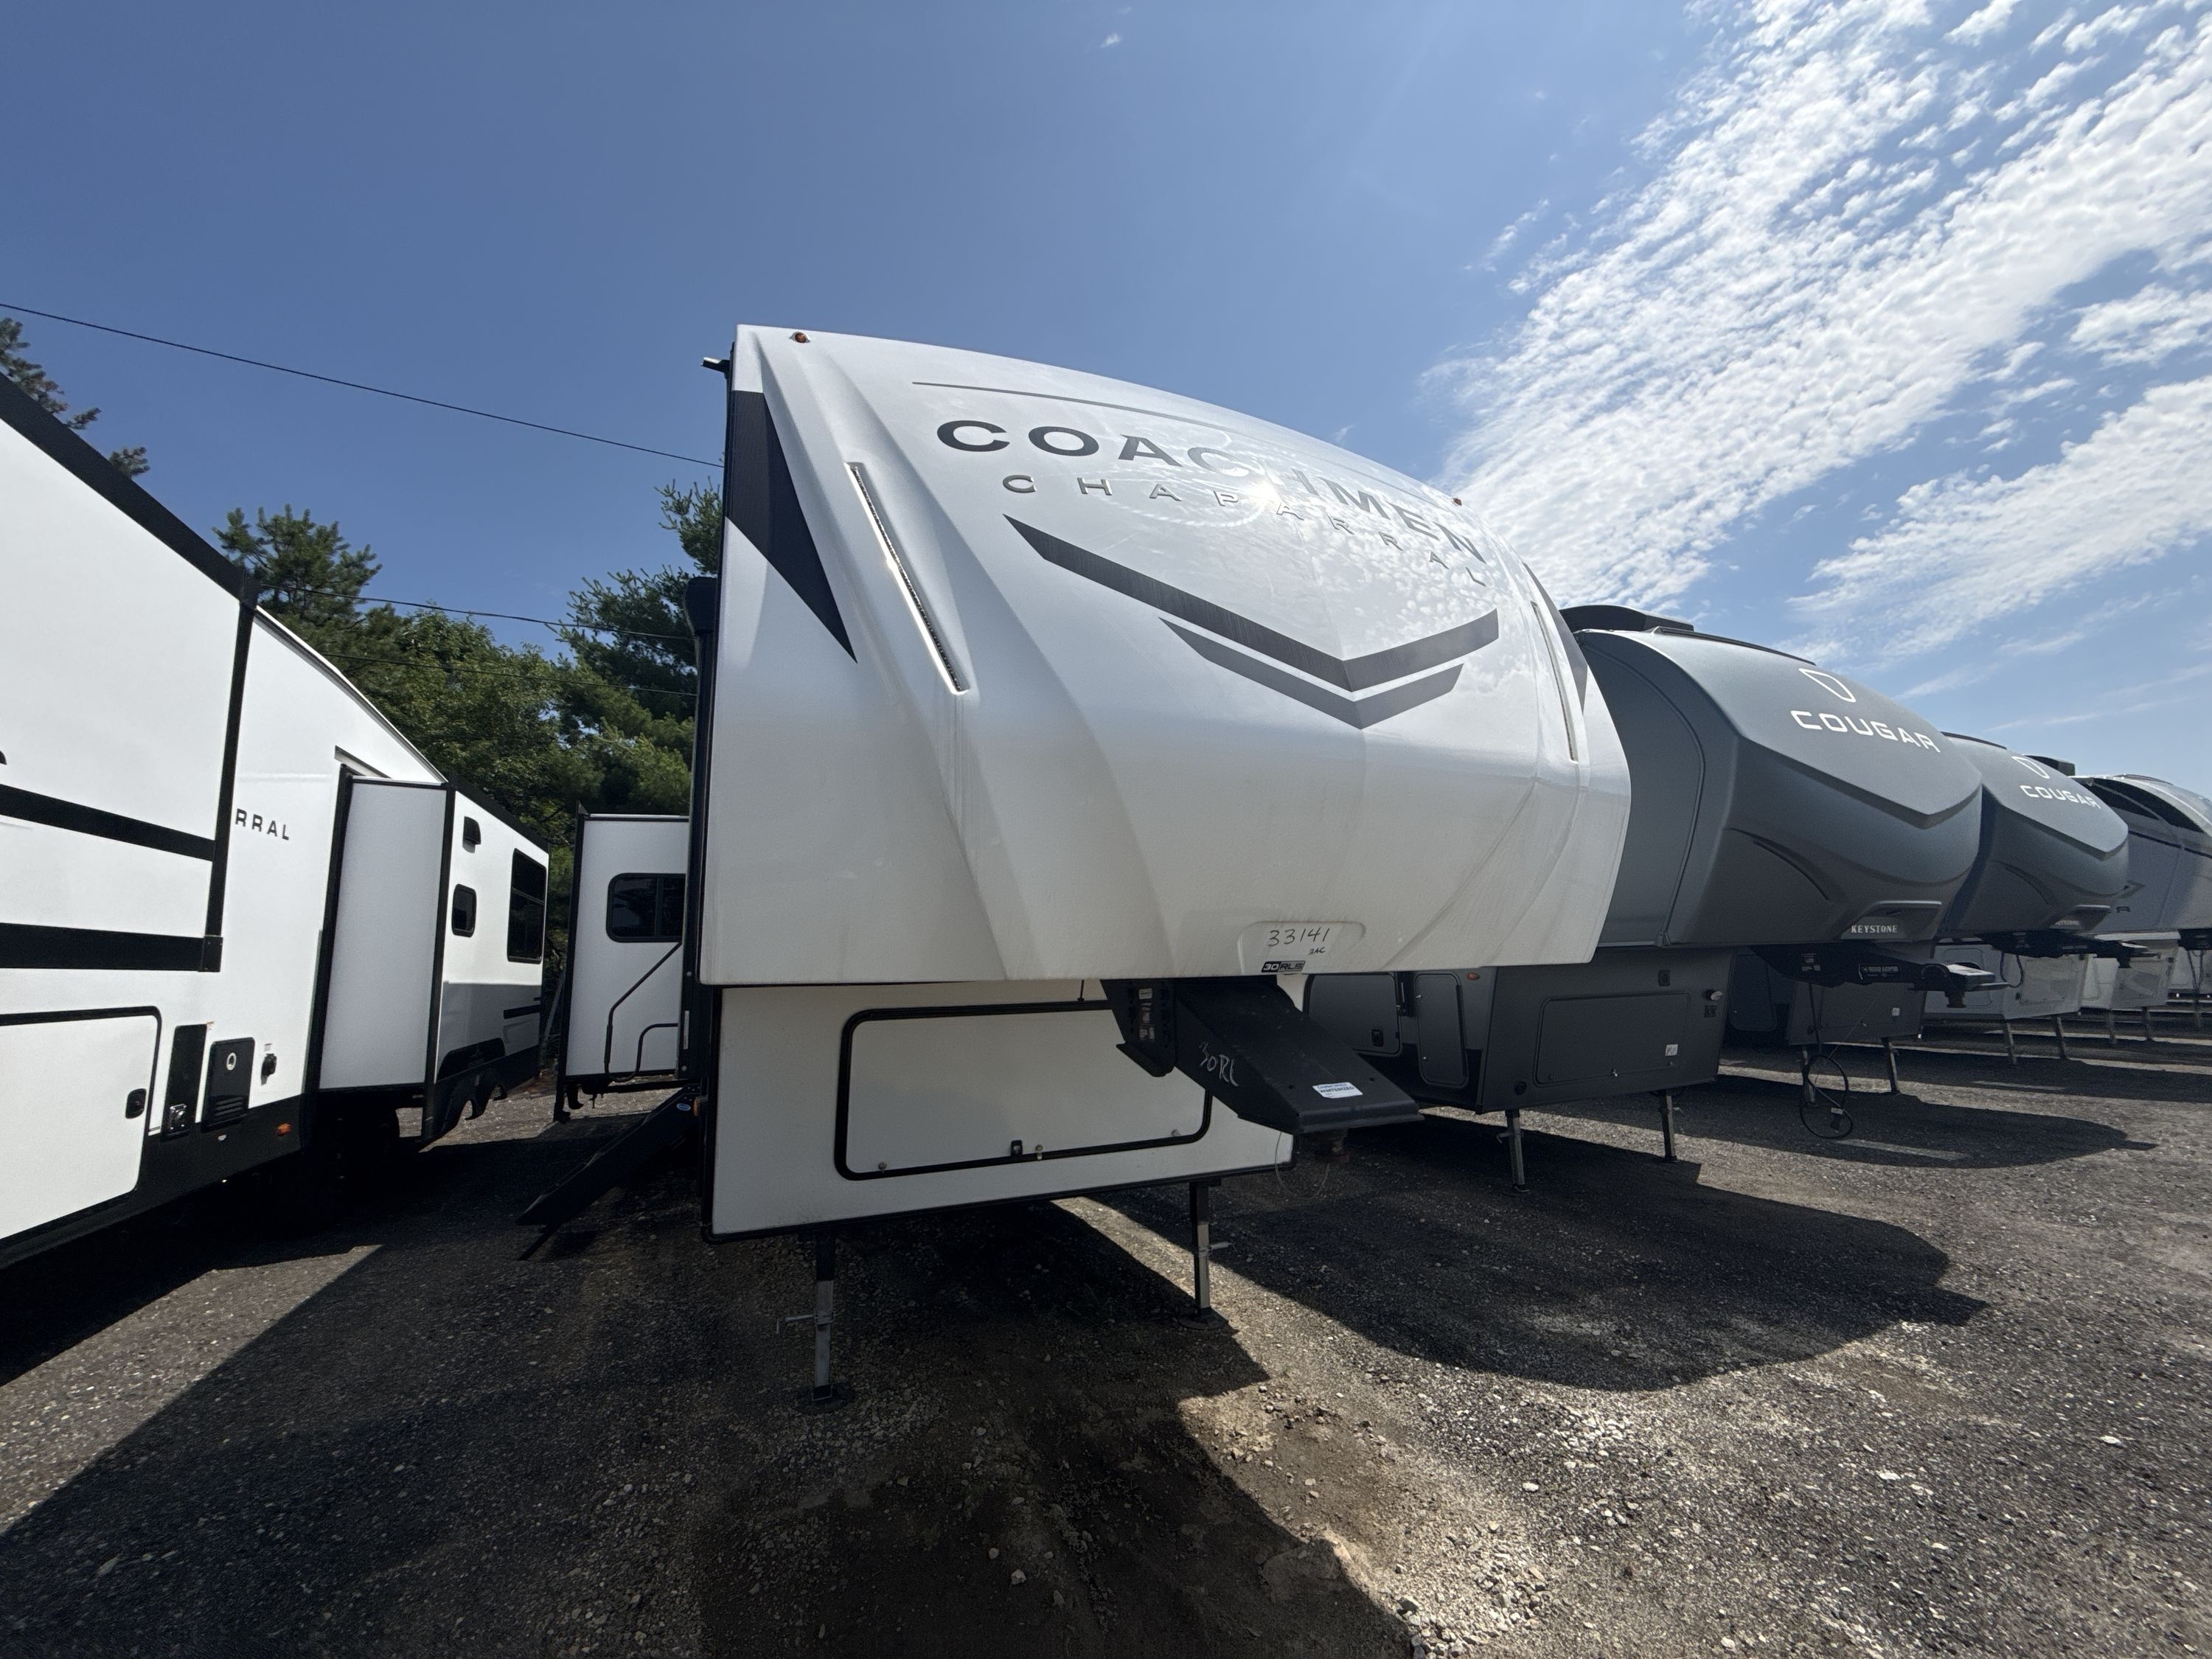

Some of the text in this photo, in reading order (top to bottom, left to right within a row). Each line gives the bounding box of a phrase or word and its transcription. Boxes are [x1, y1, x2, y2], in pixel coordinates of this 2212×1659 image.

[937, 420, 1486, 564] COACHMEN
[1002, 474, 1486, 587] CHAPARRAL
[1790, 710, 1941, 753] COUGAR
[2020, 785, 2101, 809] COUGAR
[235, 808, 289, 841] RRAL
[1267, 927, 1330, 947] 33141
[1851, 925, 1898, 933] KEYSTONE
